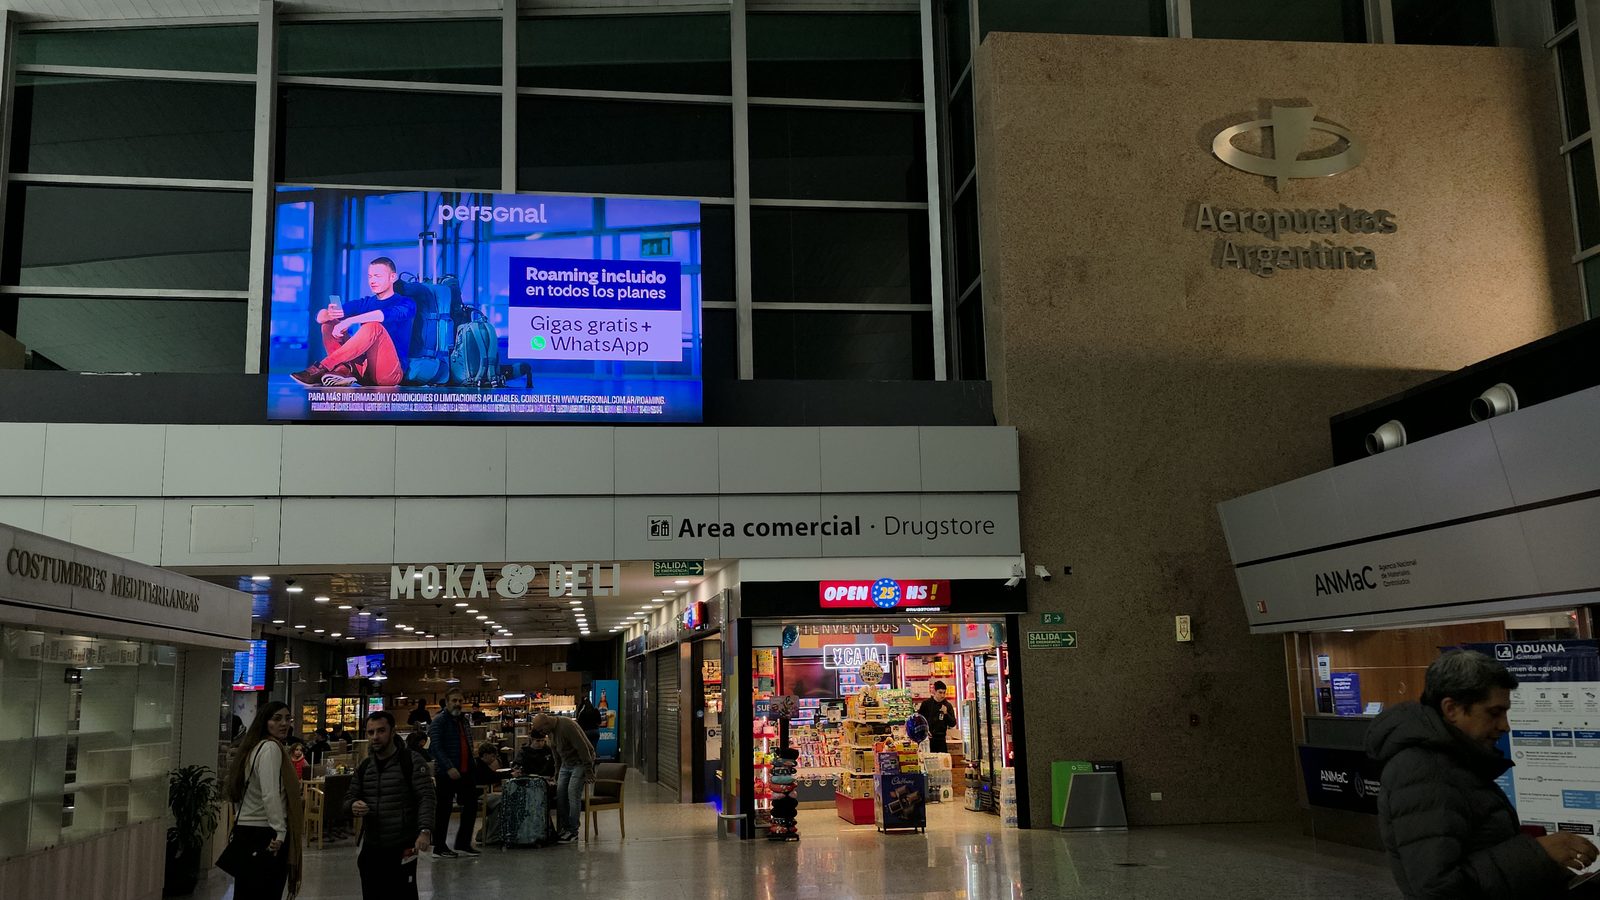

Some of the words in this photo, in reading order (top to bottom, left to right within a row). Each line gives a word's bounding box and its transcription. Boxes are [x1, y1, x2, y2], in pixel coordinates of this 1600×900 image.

[1195, 203, 1398, 240] Aeropuertos
[1220, 239, 1377, 278] Argentina
[526, 266, 599, 285] Roaming
[601, 269, 666, 284] incluido
[526, 286, 544, 296] en
[549, 285, 589, 298] todos
[593, 285, 614, 298] los
[617, 286, 666, 301] planes
[530, 315, 582, 334] Gigas
[587, 317, 638, 336] gratis
[551, 336, 649, 356] WhatsApp
[308, 392, 325, 401] PARA
[326, 391, 341, 401] MÁS
[342, 391, 386, 401] INFORMACIÓN
[386, 393, 391, 401] Y
[391, 393, 433, 402] CONDICIONES
[434, 393, 439, 402] O
[440, 393, 482, 402] LIMITACIONES
[521, 394, 551, 403] CONSULTE
[552, 395, 560, 403] EN
[678, 518, 735, 538] Area
[743, 515, 861, 537] comercial
[885, 516, 995, 540] Drugstore
[655, 561, 687, 570] SALIDA
[6, 548, 107, 592] COSTUMBRES
[110, 572, 200, 614] MEDITERRANEAS
[390, 564, 490, 600] MOKA
[496, 563, 535, 598] &
[548, 563, 621, 597] DELI
[1314, 565, 1377, 597] ANMaC
[824, 585, 868, 601] OPEN
[879, 586, 896, 600] 25
[799, 624, 900, 634] IENVENIDOS
[1030, 633, 1060, 641] SALIDA
[429, 649, 468, 665] MOKA
[844, 647, 881, 666] CAJA
[1515, 643, 1565, 654] ADUANA
[1538, 664, 1567, 673] equipaje
[1320, 769, 1349, 784] ANMaC
